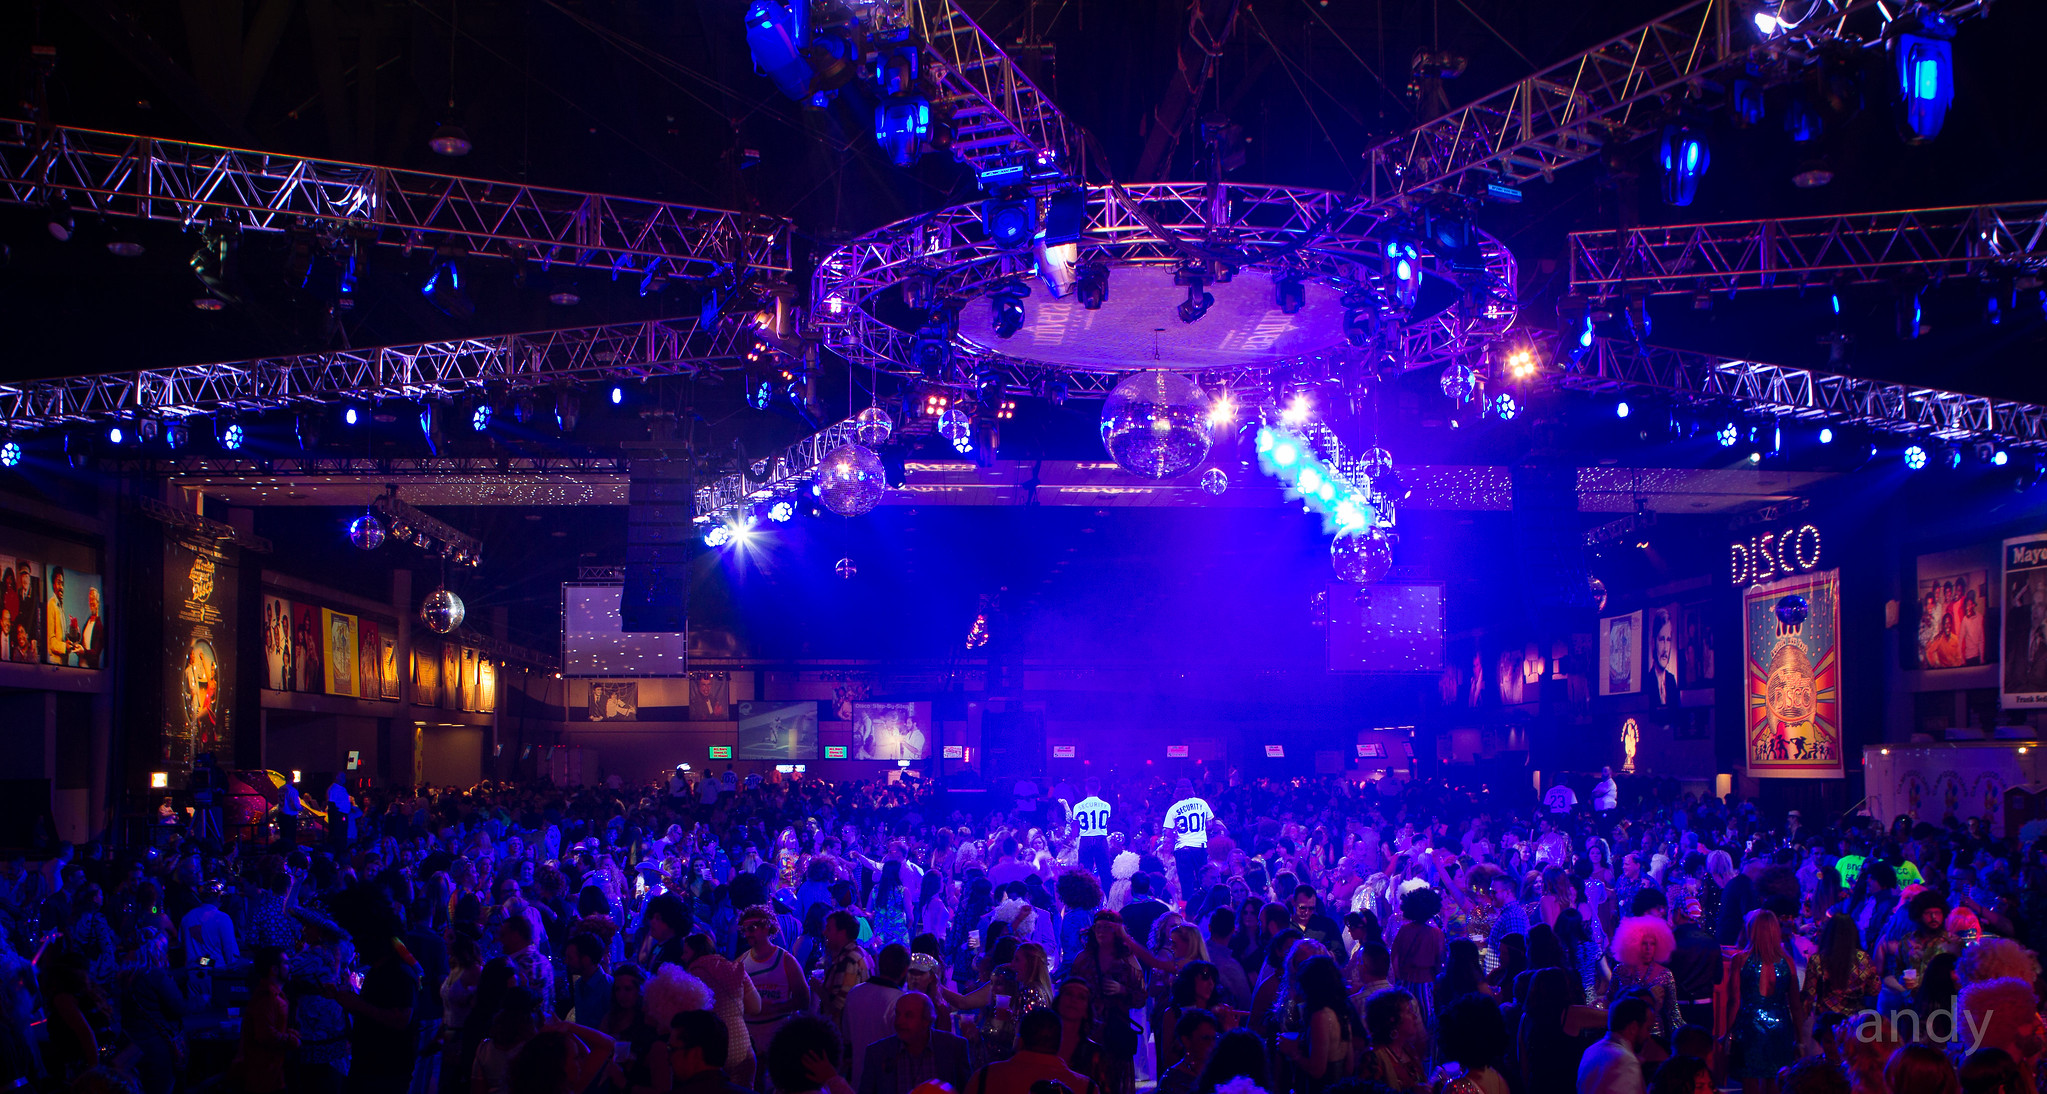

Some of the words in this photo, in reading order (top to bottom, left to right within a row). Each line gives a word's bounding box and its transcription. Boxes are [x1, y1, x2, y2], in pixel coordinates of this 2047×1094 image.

[1731, 524, 1821, 584] DISCO
[1775, 687, 1813, 710] DISCO
[1079, 802, 1108, 810] SECURITY
[1176, 802, 1203, 815] SECURITY
[1550, 795, 1566, 809] 23
[1077, 810, 1109, 831] 310
[1175, 812, 1206, 834] 301
